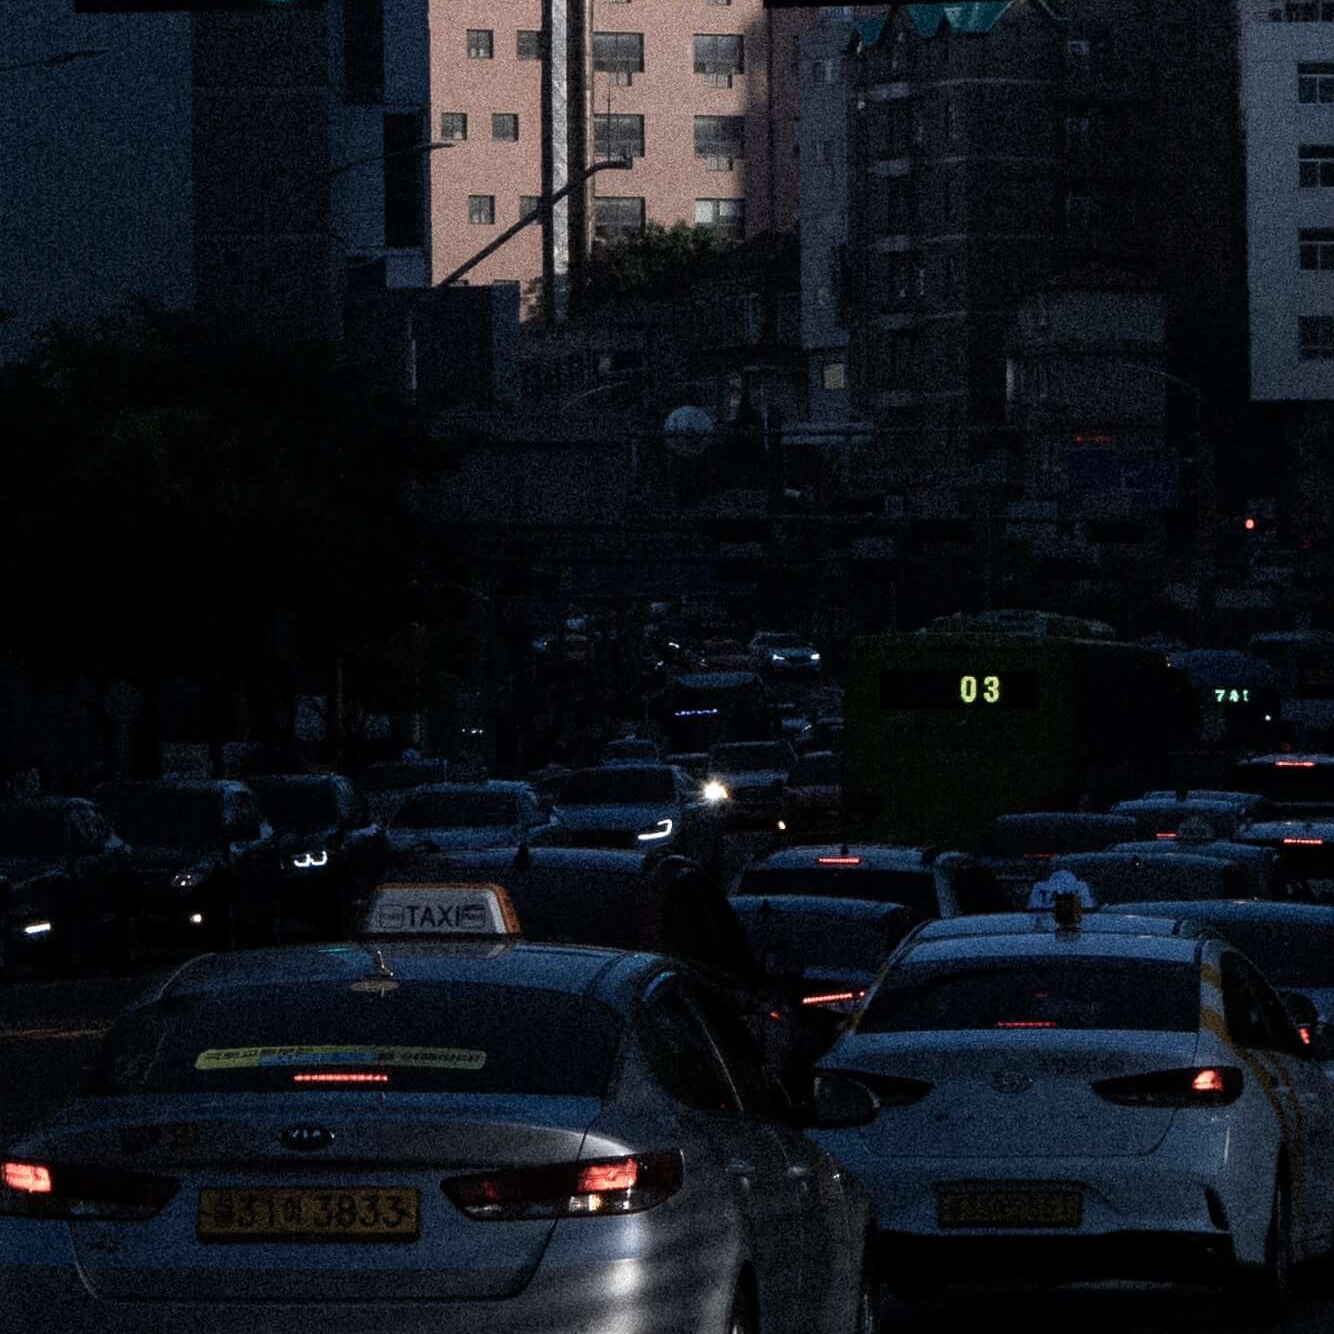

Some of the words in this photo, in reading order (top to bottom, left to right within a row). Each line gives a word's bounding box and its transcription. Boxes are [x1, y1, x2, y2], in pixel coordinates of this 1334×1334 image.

[959, 676, 1001, 704] 03
[406, 905, 460, 928] TAXI
[312, 1193, 406, 1229] 3833
